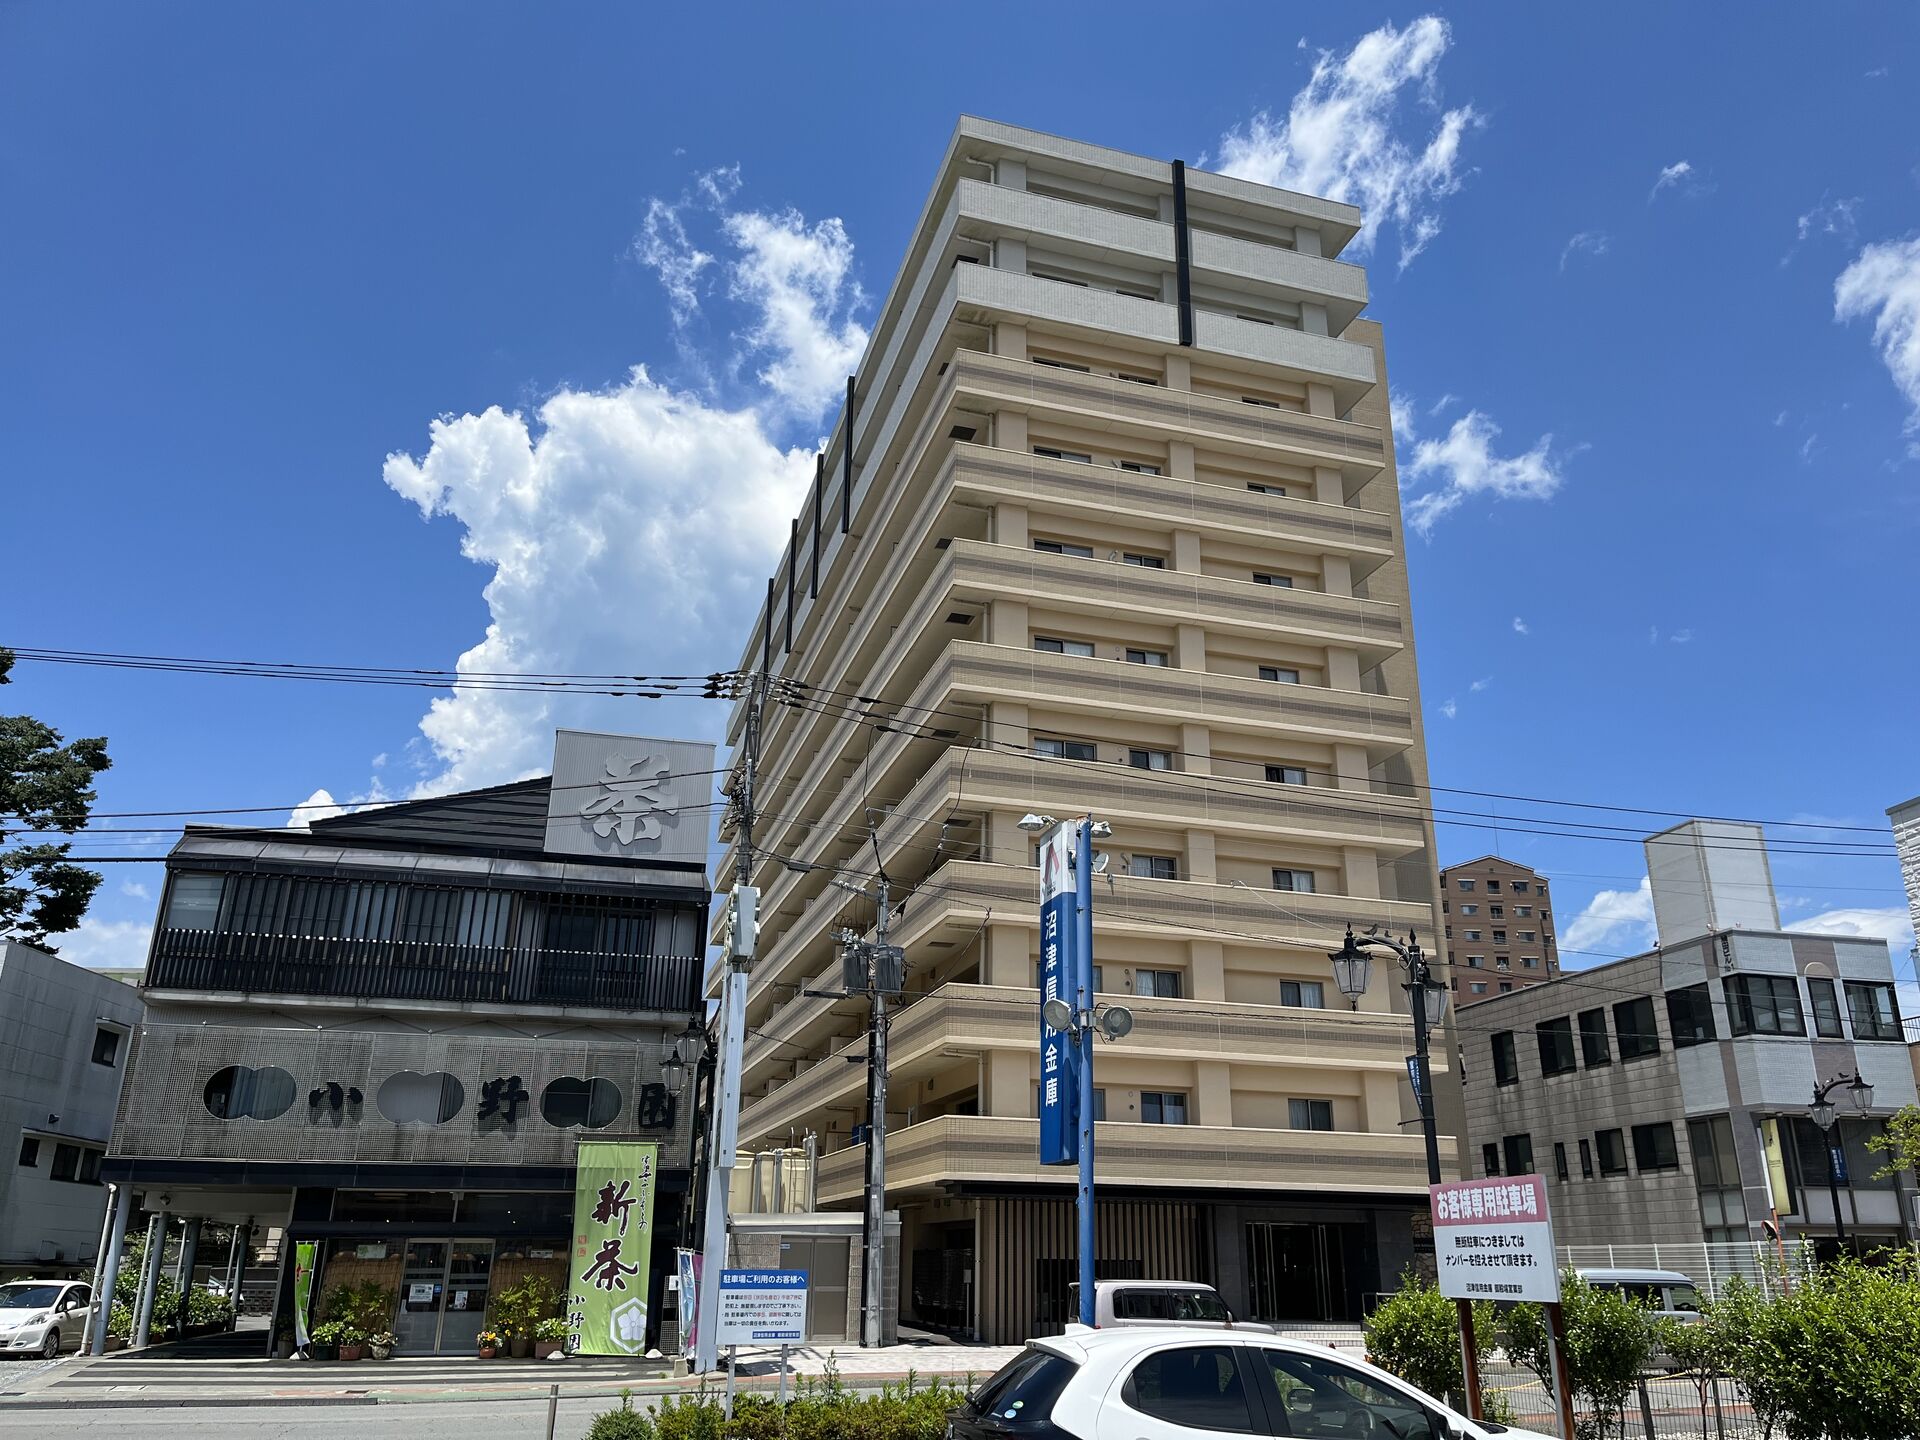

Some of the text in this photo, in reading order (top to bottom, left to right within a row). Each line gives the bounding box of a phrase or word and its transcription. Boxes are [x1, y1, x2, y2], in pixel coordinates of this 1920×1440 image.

[580, 753, 679, 846] 茶
[1437, 1183, 1538, 1220] お客様専用駐車場
[580, 1180, 639, 1292] 新茶
[1455, 1235, 1525, 1248] 無断駐車につきましては
[723, 1274, 805, 1284] 駐車場ご利用のお客様へ
[1445, 1254, 1538, 1267] ナンバーを控えさせて頂きます。
[568, 1294, 586, 1353] 小野園
